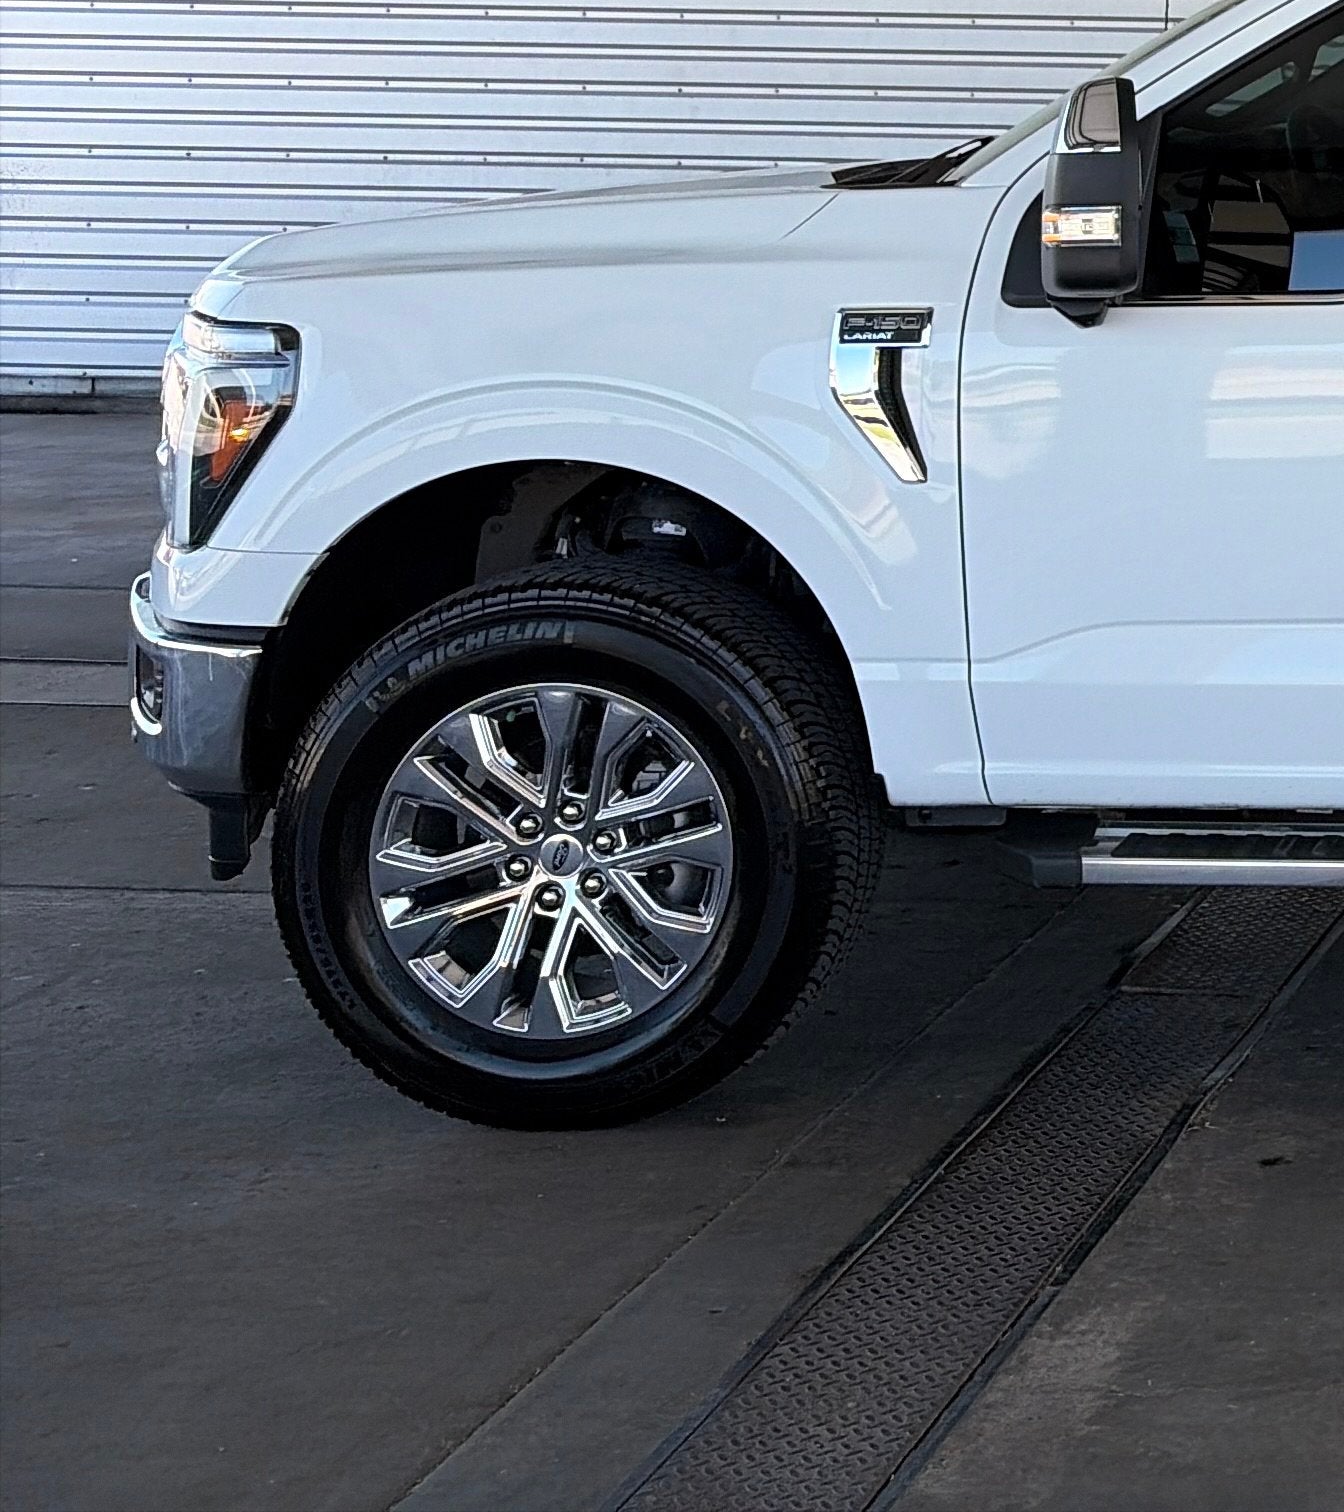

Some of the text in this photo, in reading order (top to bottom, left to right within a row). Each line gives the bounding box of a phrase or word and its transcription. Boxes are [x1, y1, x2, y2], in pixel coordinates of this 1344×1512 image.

[843, 316, 922, 330] F-150
[843, 331, 895, 340] LARIAT
[407, 620, 565, 681] MICHELIN
